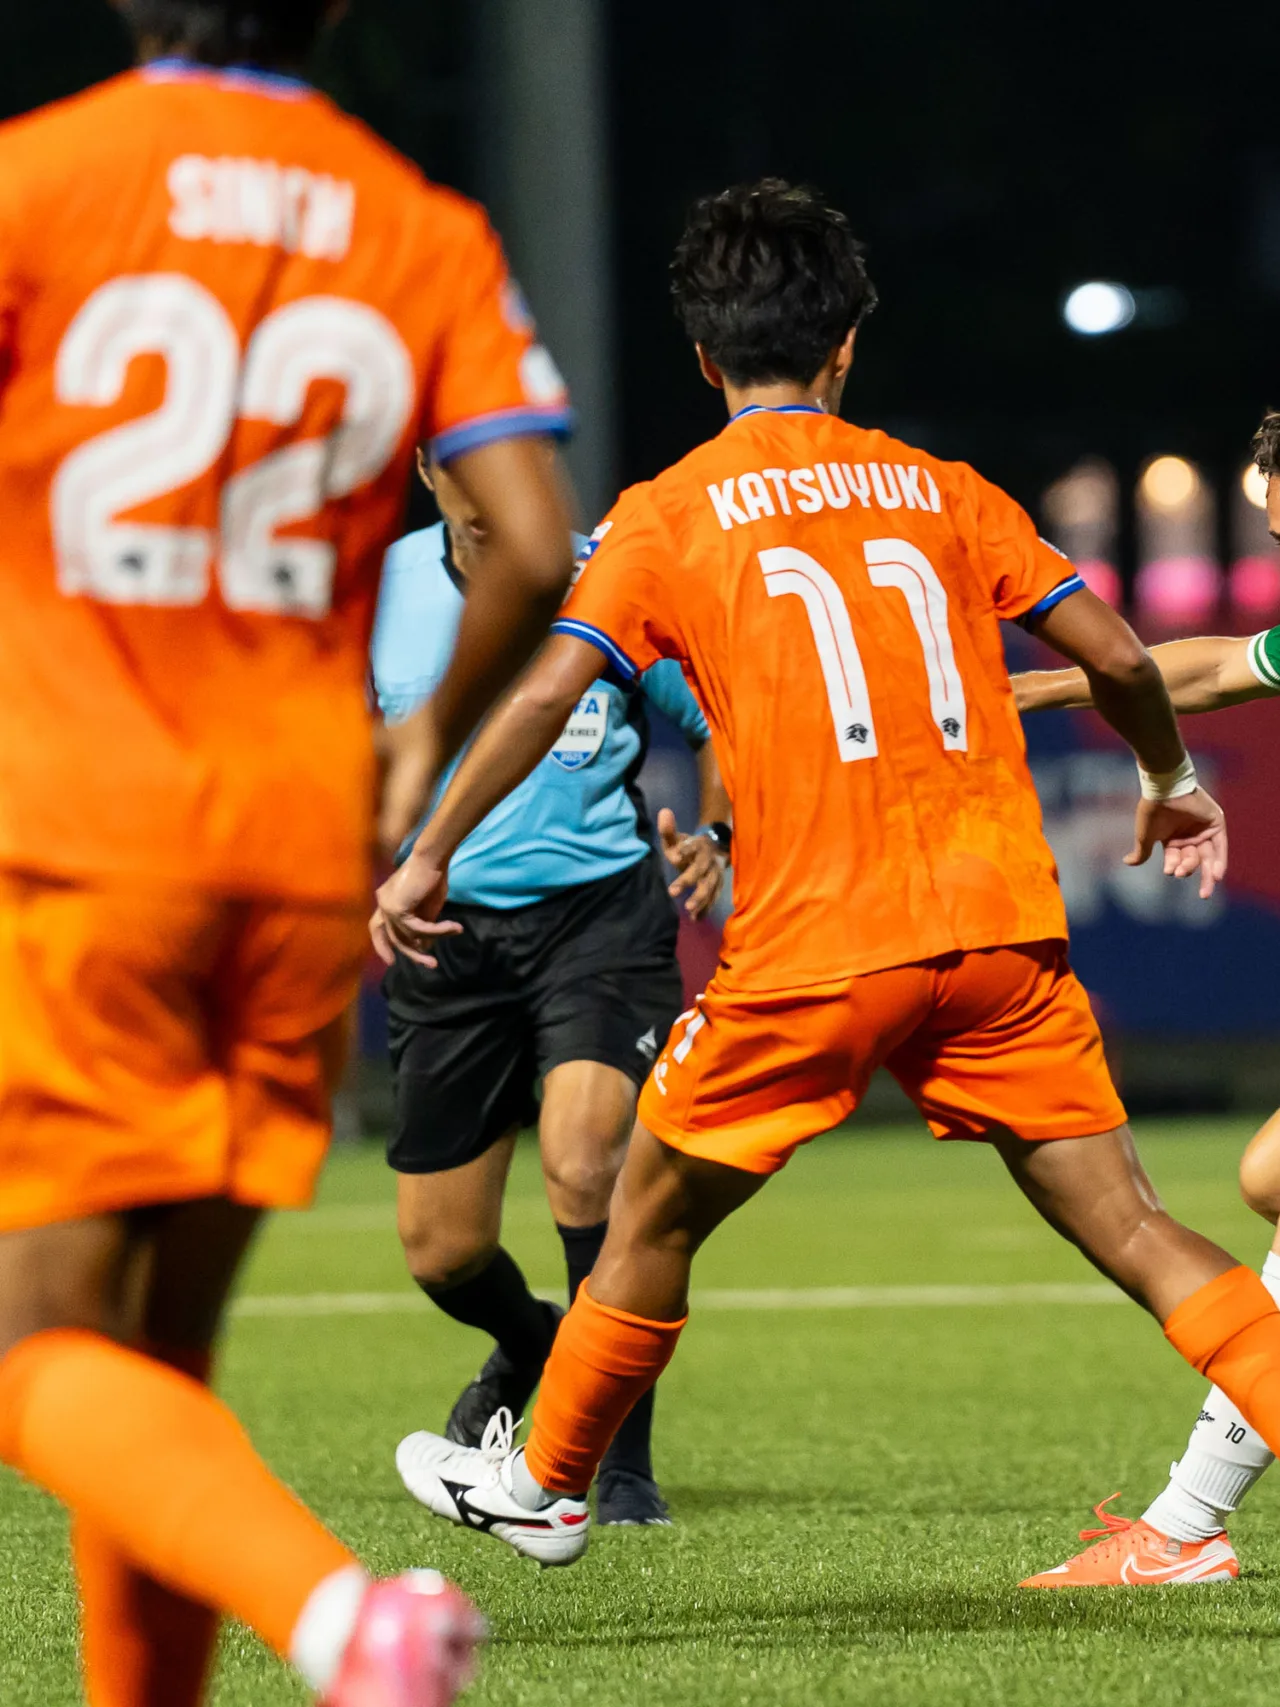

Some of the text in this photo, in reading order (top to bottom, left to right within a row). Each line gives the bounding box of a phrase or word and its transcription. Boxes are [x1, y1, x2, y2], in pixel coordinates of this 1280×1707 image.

[51, 272, 415, 620] 22
[706, 462, 941, 530] KATSUYUKI
[757, 538, 968, 763] 11
[1225, 1421, 1247, 1444] 10
